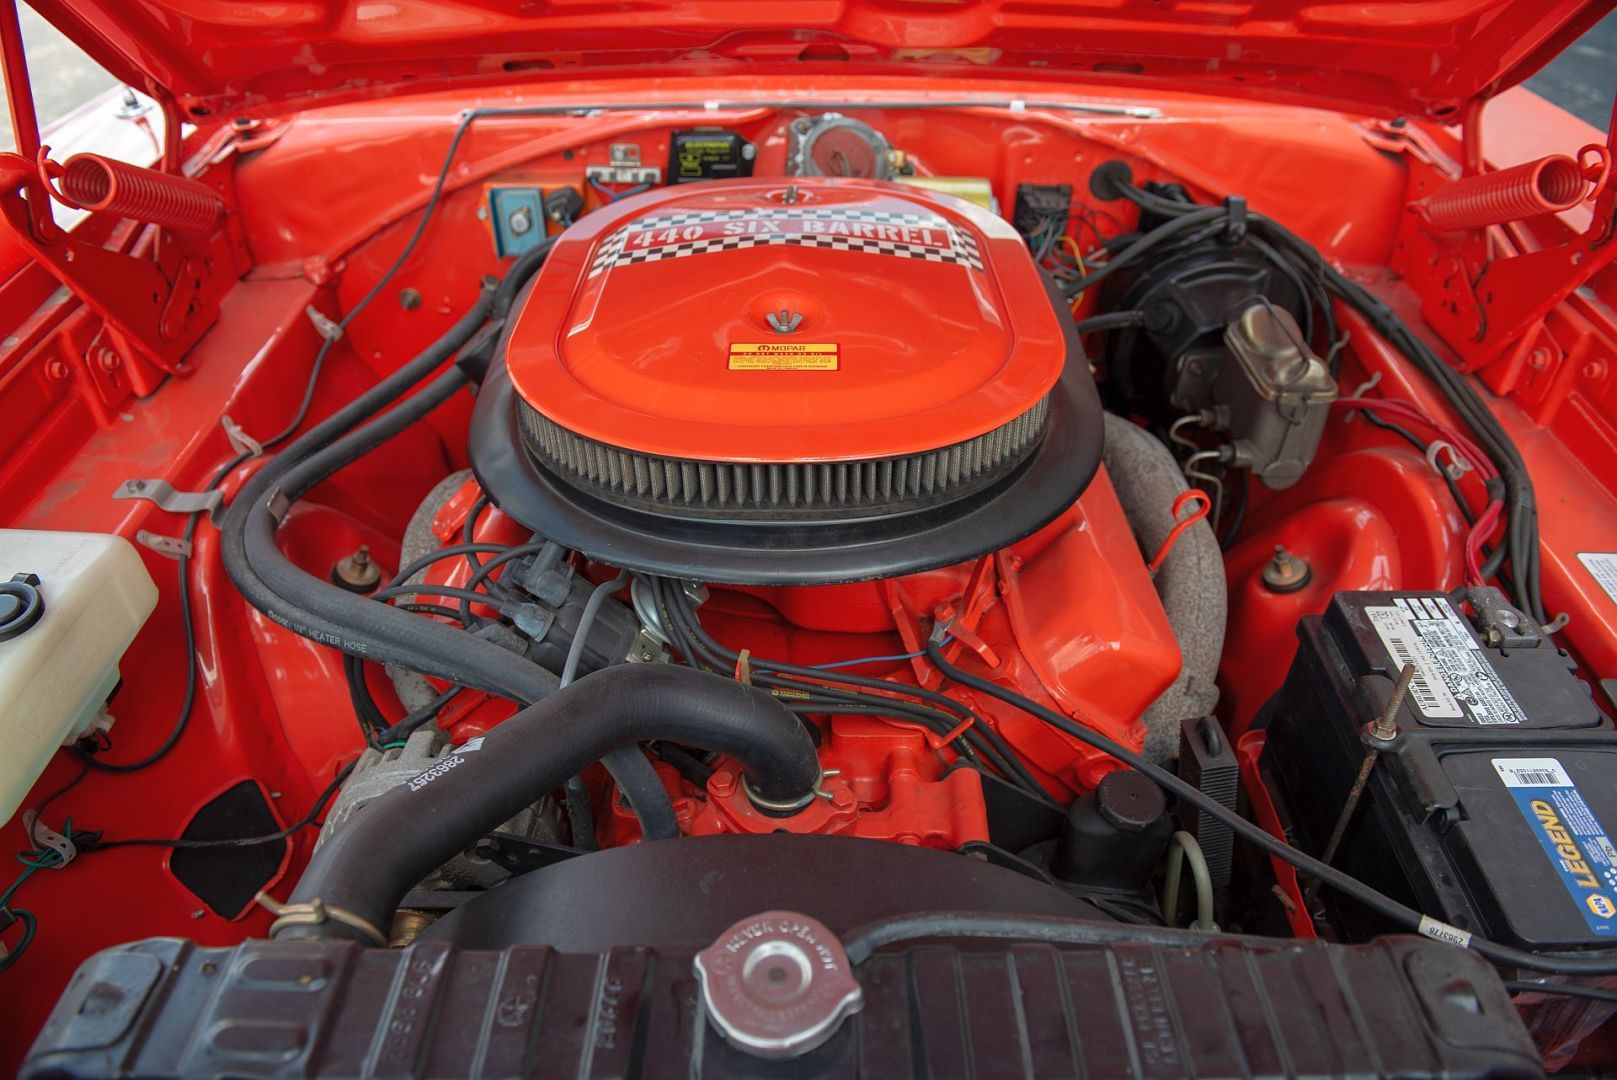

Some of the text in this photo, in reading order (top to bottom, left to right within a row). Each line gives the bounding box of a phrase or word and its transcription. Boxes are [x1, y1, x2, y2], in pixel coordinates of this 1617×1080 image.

[632, 220, 944, 248] 440 SIX BARREL
[309, 629, 341, 646] HEATER
[343, 639, 368, 653] HOSE
[407, 755, 465, 792] 2863257
[1530, 800, 1600, 887] LEGEND
[1592, 897, 1610, 914] NAPA
[726, 921, 774, 953] NEVER
